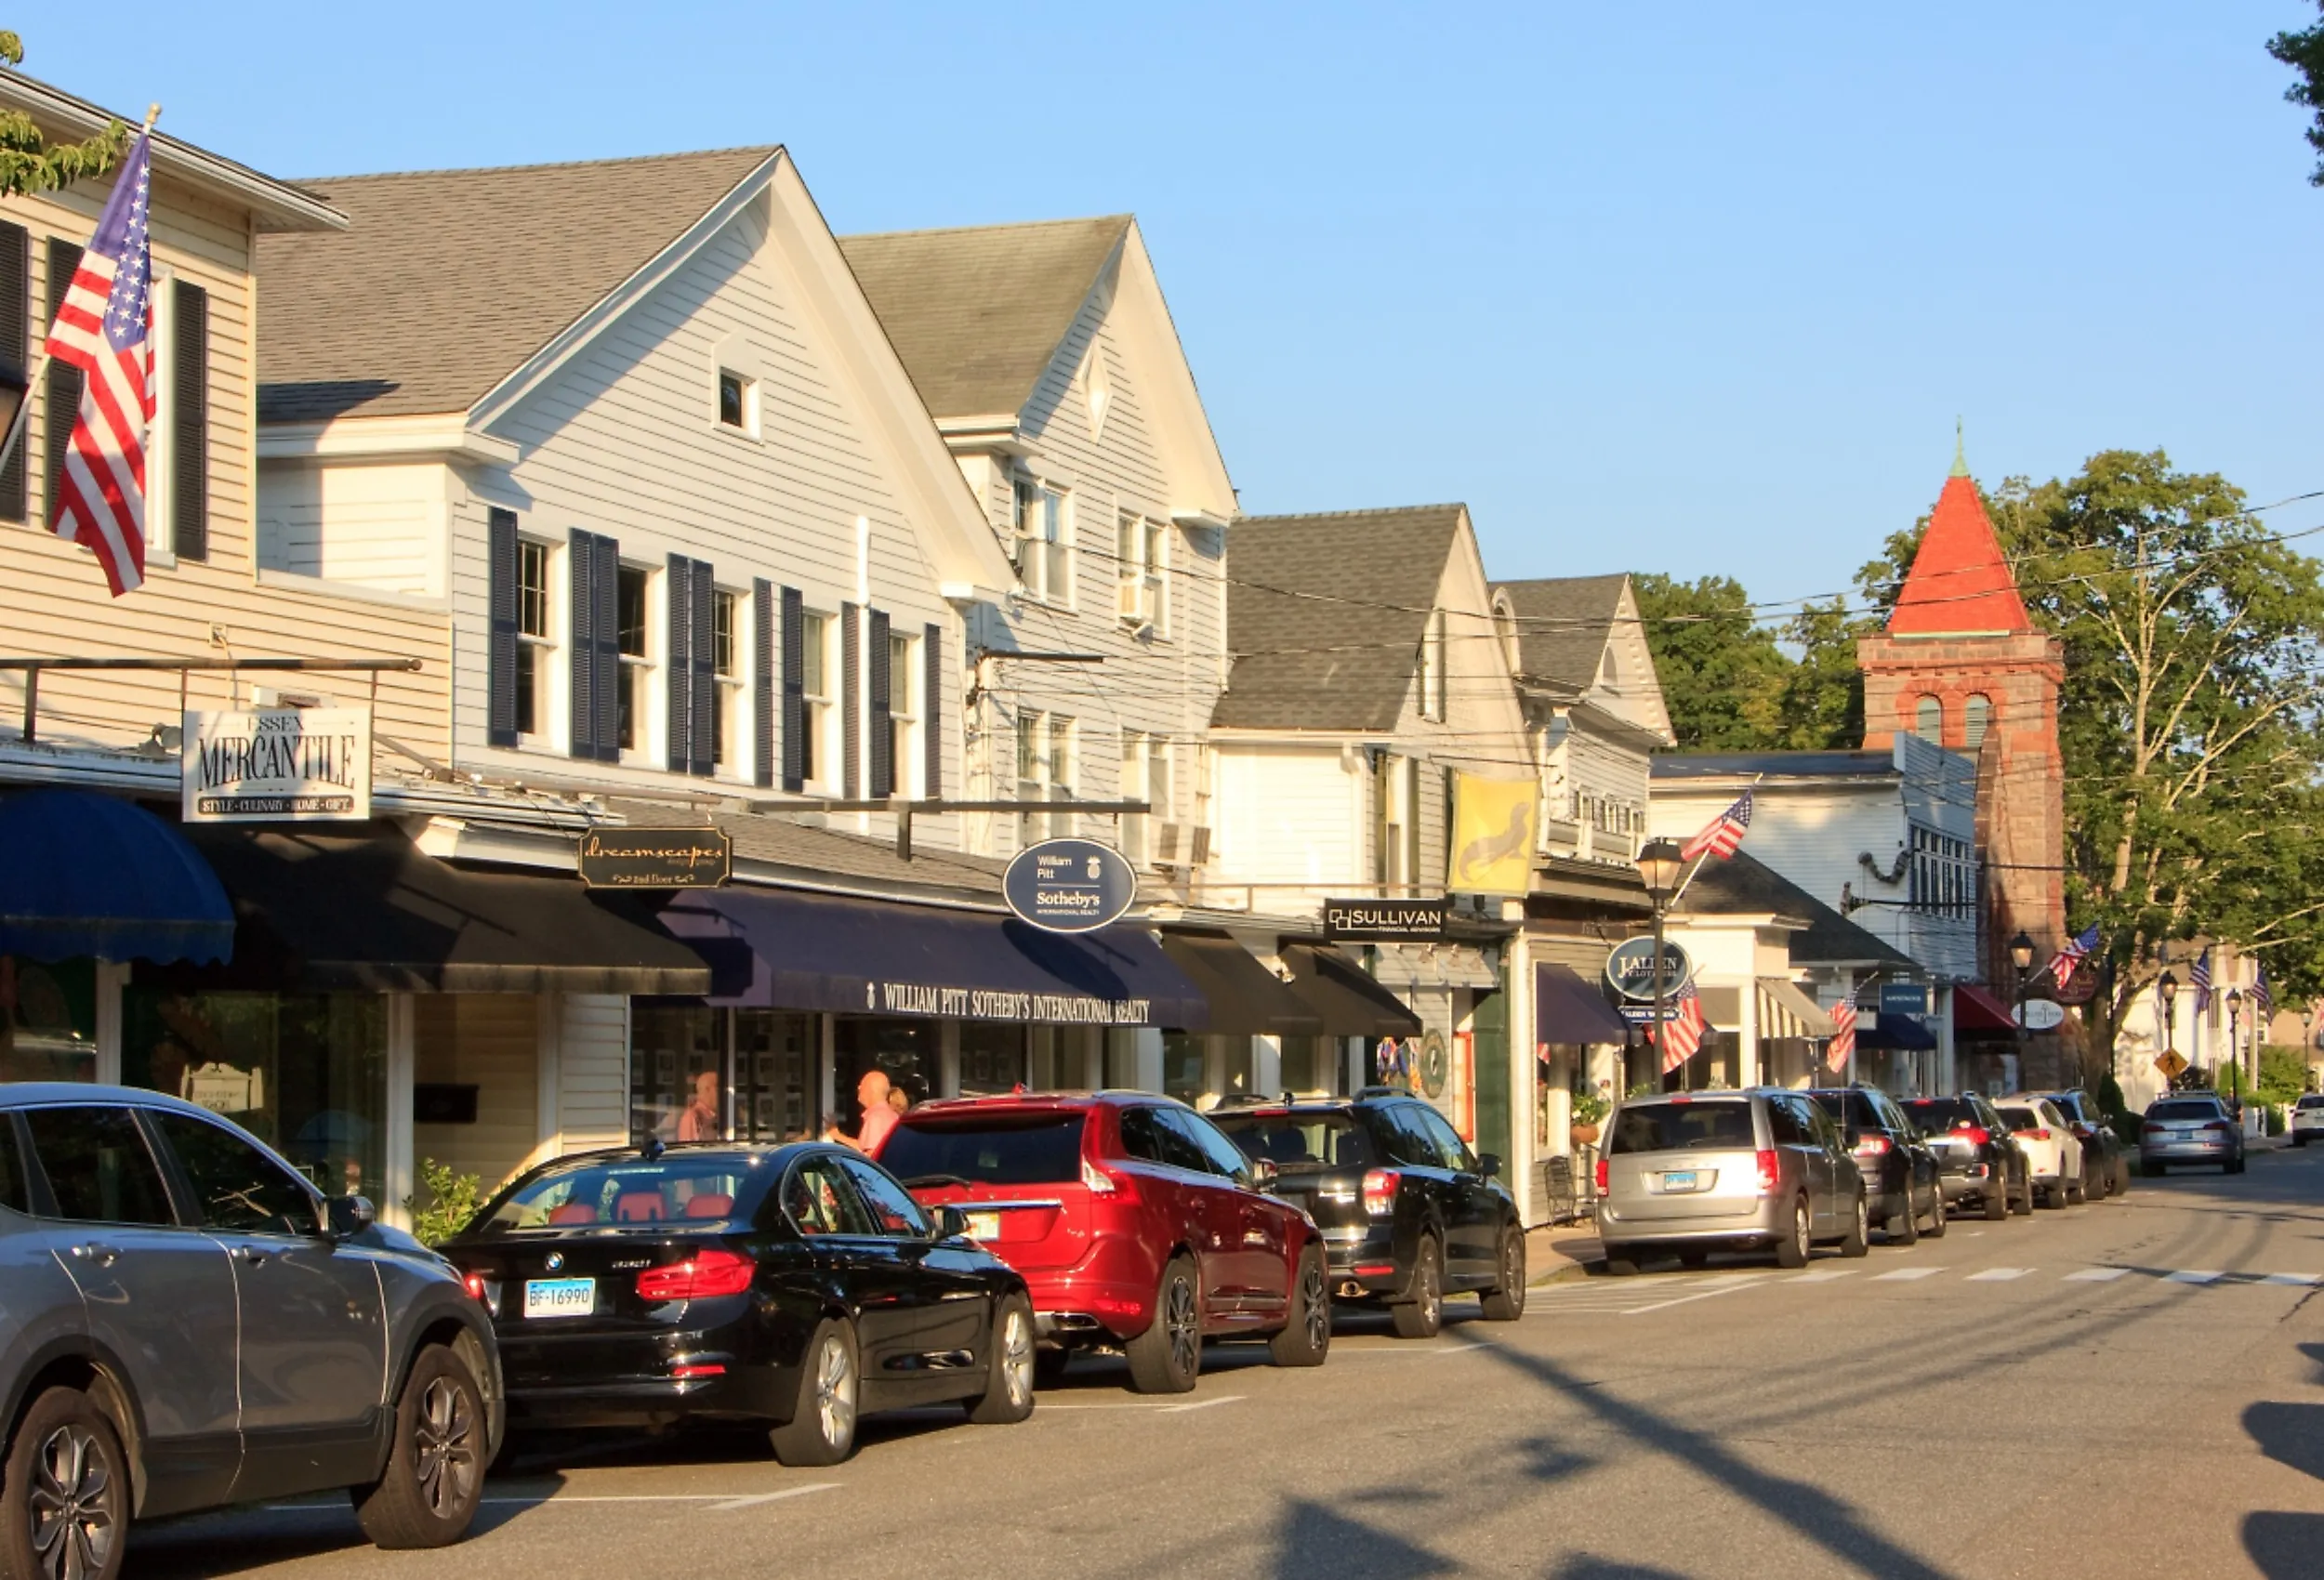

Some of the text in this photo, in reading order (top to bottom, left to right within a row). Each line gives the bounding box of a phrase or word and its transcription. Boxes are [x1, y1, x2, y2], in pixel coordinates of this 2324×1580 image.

[198, 734, 355, 792] MERCANTILE
[202, 797, 350, 813] STYLE CULINARY HOME GIFT
[585, 836, 723, 869] dreamscapes
[1037, 854, 1073, 867] William
[1037, 868, 1055, 880] Pitt
[1037, 890, 1101, 909] Sotheby's
[1353, 910, 1442, 926] SULLIVAN
[883, 981, 1151, 1023] WILLIAM PITT SOTHEBY'S INTERNATIONAL REALTY
